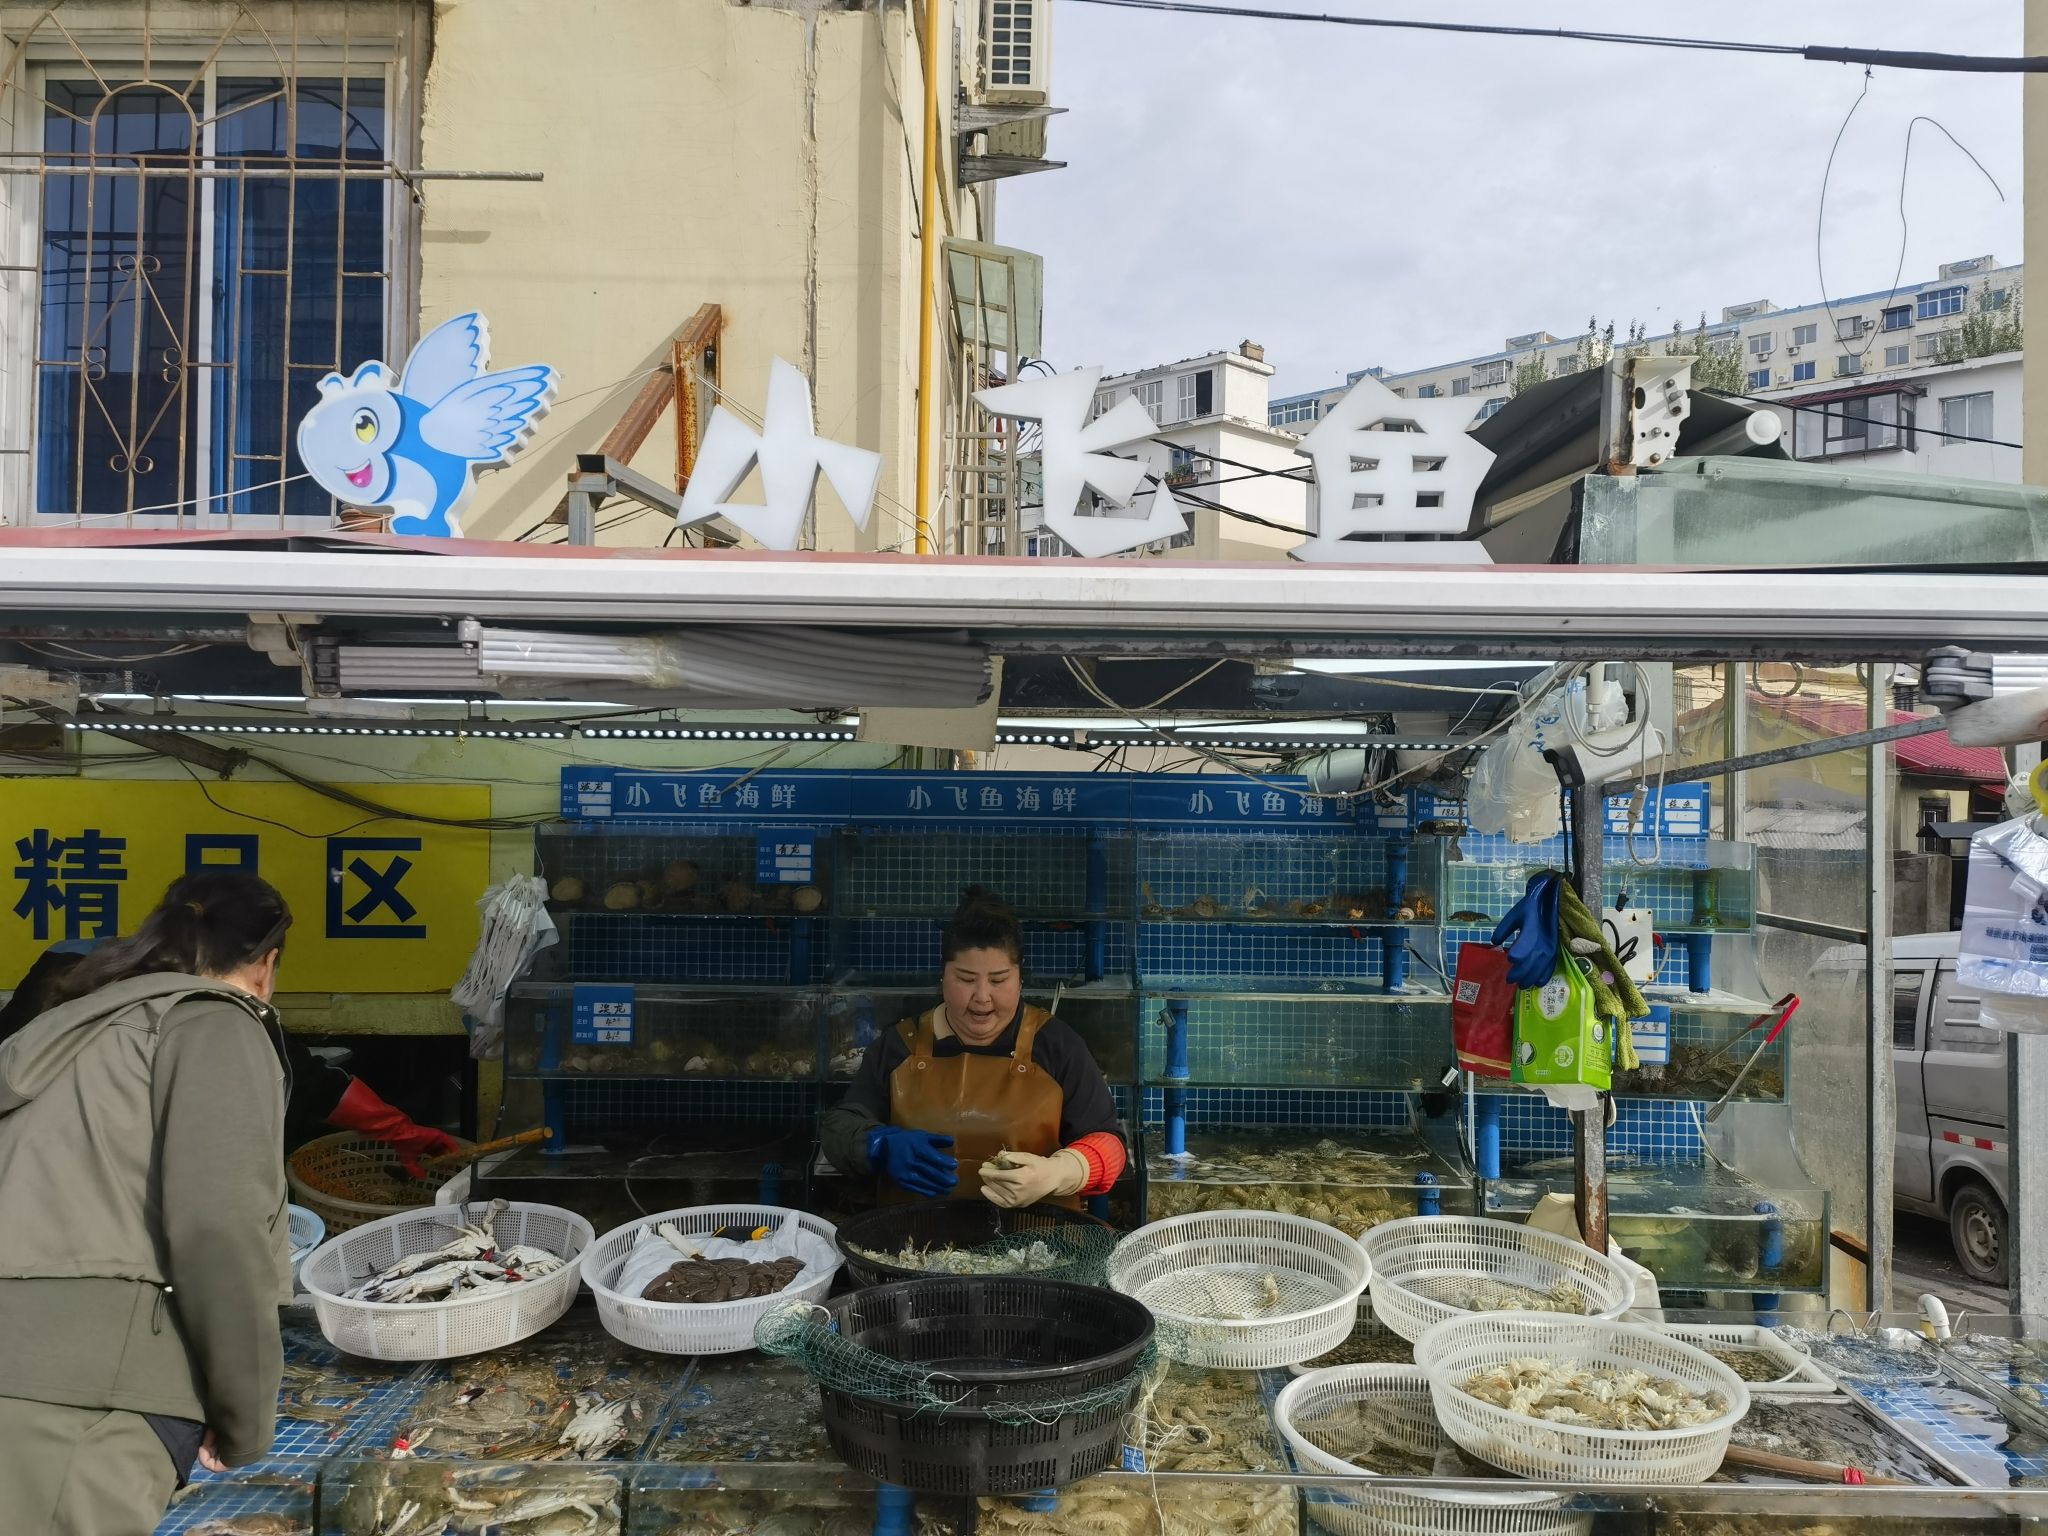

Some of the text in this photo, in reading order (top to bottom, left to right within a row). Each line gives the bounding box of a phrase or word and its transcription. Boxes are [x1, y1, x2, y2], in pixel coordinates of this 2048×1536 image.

[676, 354, 1497, 564] 小飞鱼
[625, 782, 797, 809] 小飞鱼海鲜
[907, 785, 1078, 812] 小飞鱼海鲜
